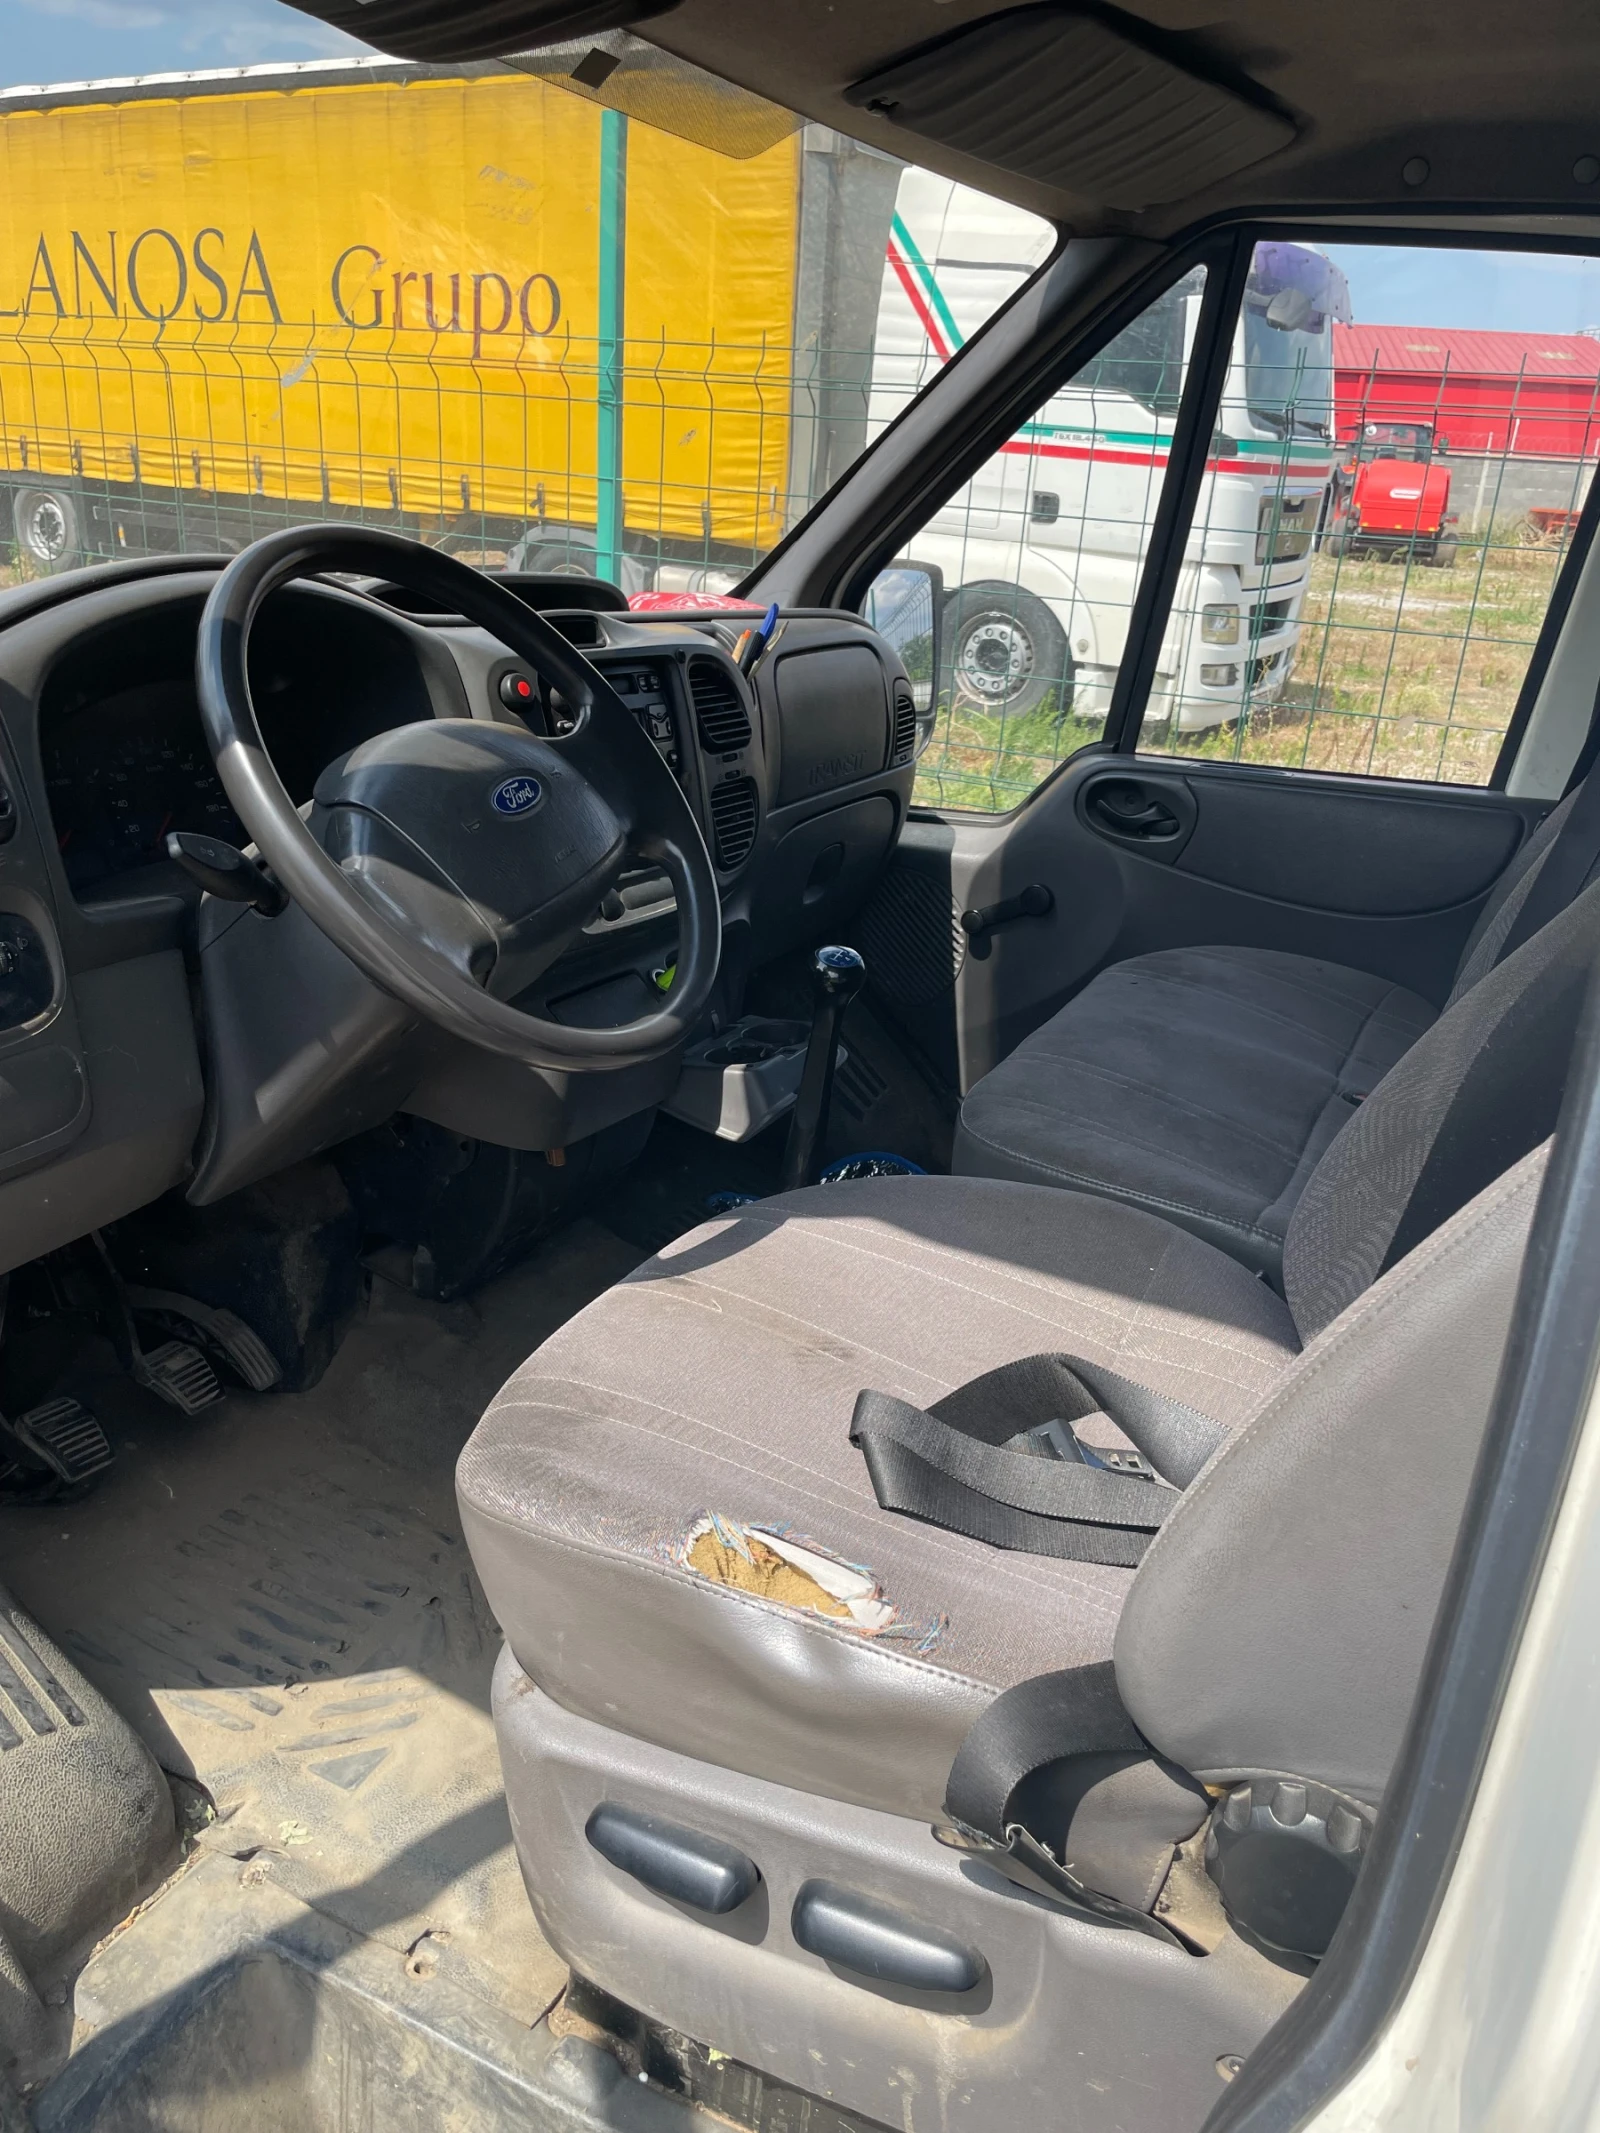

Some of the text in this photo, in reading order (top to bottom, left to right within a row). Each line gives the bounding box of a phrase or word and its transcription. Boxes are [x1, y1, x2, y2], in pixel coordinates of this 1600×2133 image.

[0, 228, 562, 359] ANOSA Grupo
[807, 750, 867, 786] TRANSIT
[502, 782, 535, 808] Ford
